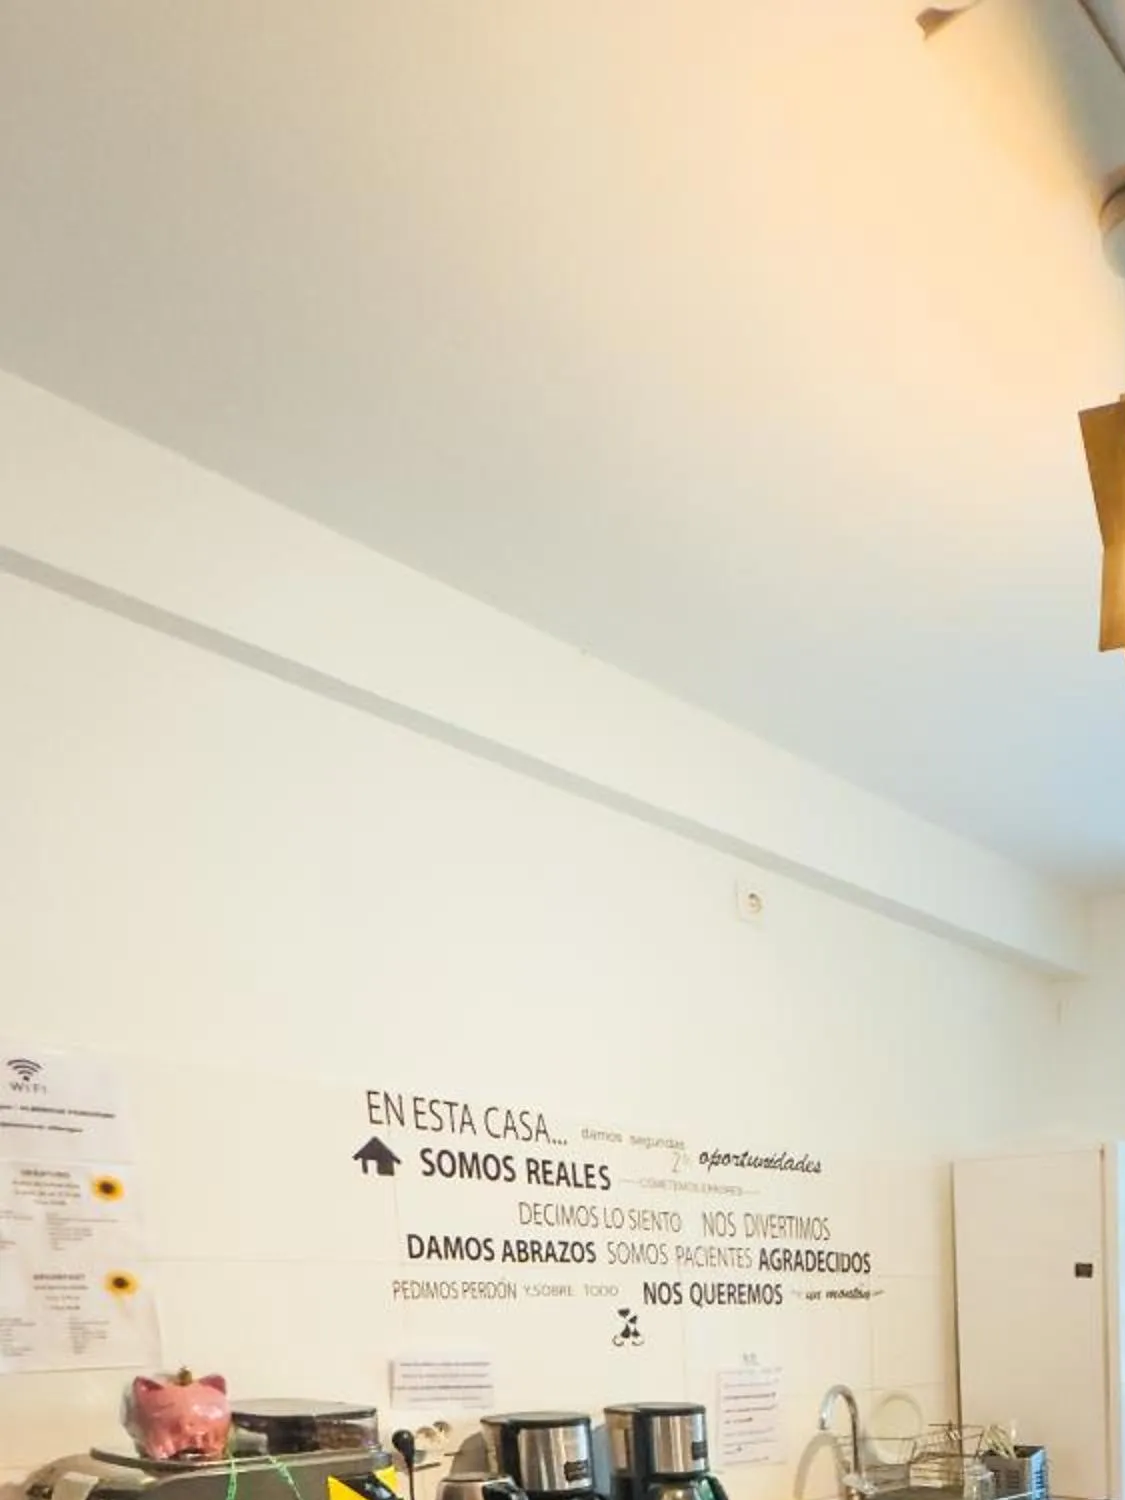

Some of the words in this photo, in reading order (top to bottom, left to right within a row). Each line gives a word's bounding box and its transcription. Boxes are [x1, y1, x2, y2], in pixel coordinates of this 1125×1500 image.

[366, 1090, 405, 1127] EN
[412, 1096, 477, 1136] ESTA
[581, 1128, 622, 1143] damos
[420, 1148, 516, 1182] SOMOS
[526, 1157, 611, 1190] REALES
[699, 1147, 822, 1174] oportunidades
[518, 1201, 599, 1228] DECIMOS
[603, 1206, 625, 1230] LO
[628, 1208, 682, 1233] SIENTO
[702, 1211, 737, 1237] NOS
[744, 1213, 831, 1241] DIVERTIMOS
[406, 1234, 495, 1262] DAMOS
[501, 1239, 597, 1263] ABRAZOS
[607, 1241, 669, 1265] SOMOS
[676, 1244, 752, 1269] PACIENTES
[758, 1247, 872, 1274] AGRADECIDOS
[392, 1280, 458, 1300] PEDIMOS
[462, 1276, 517, 1300] PERDÓN
[584, 1284, 619, 1297] TODO
[643, 1281, 683, 1305] NOS
[689, 1282, 783, 1307] QUEREMOS
